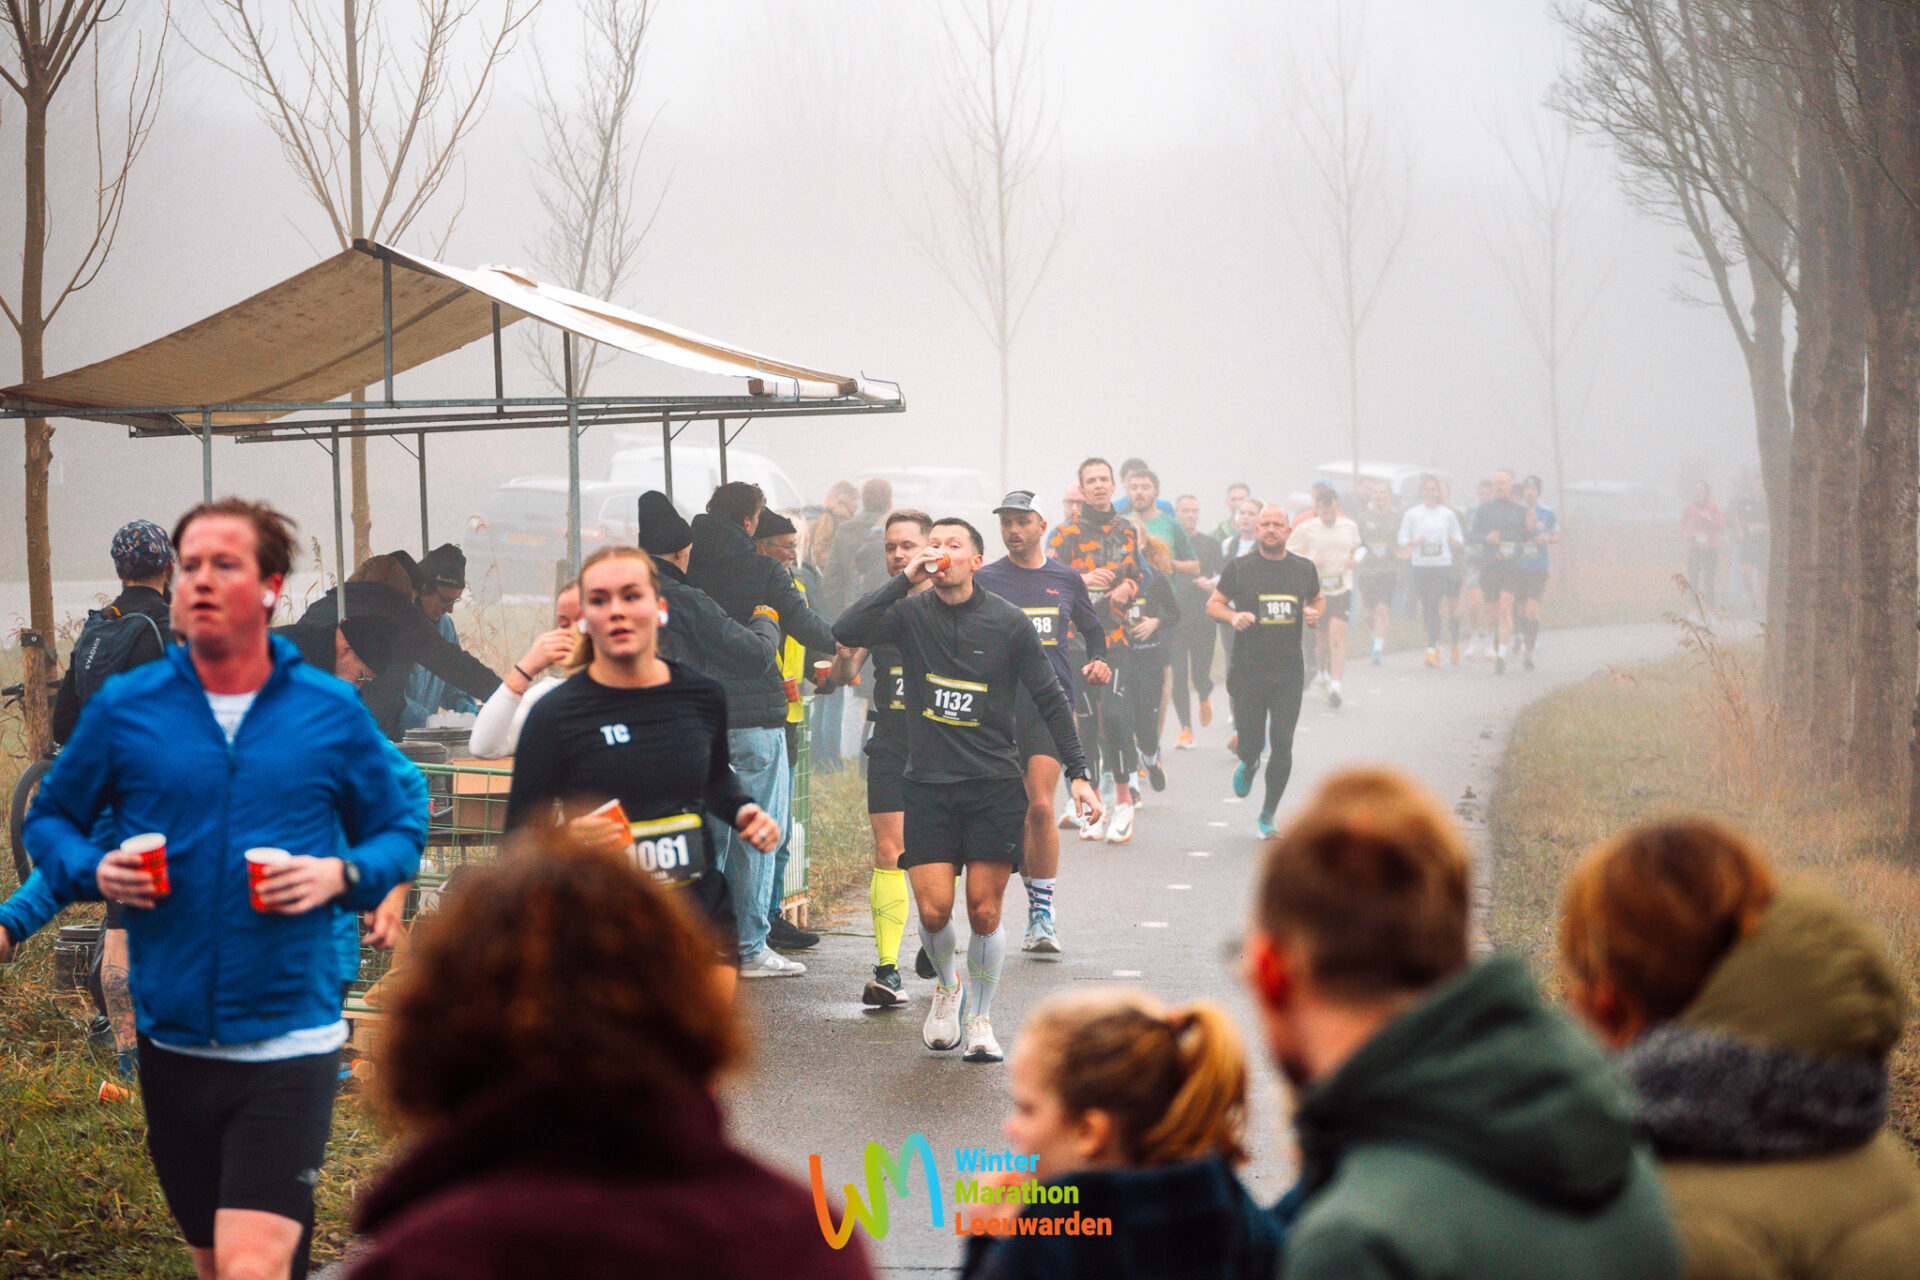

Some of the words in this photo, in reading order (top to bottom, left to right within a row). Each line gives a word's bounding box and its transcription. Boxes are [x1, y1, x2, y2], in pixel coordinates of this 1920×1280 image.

[1266, 601, 1290, 615] 1814
[934, 689, 973, 712] 1132
[600, 723, 631, 745] TC
